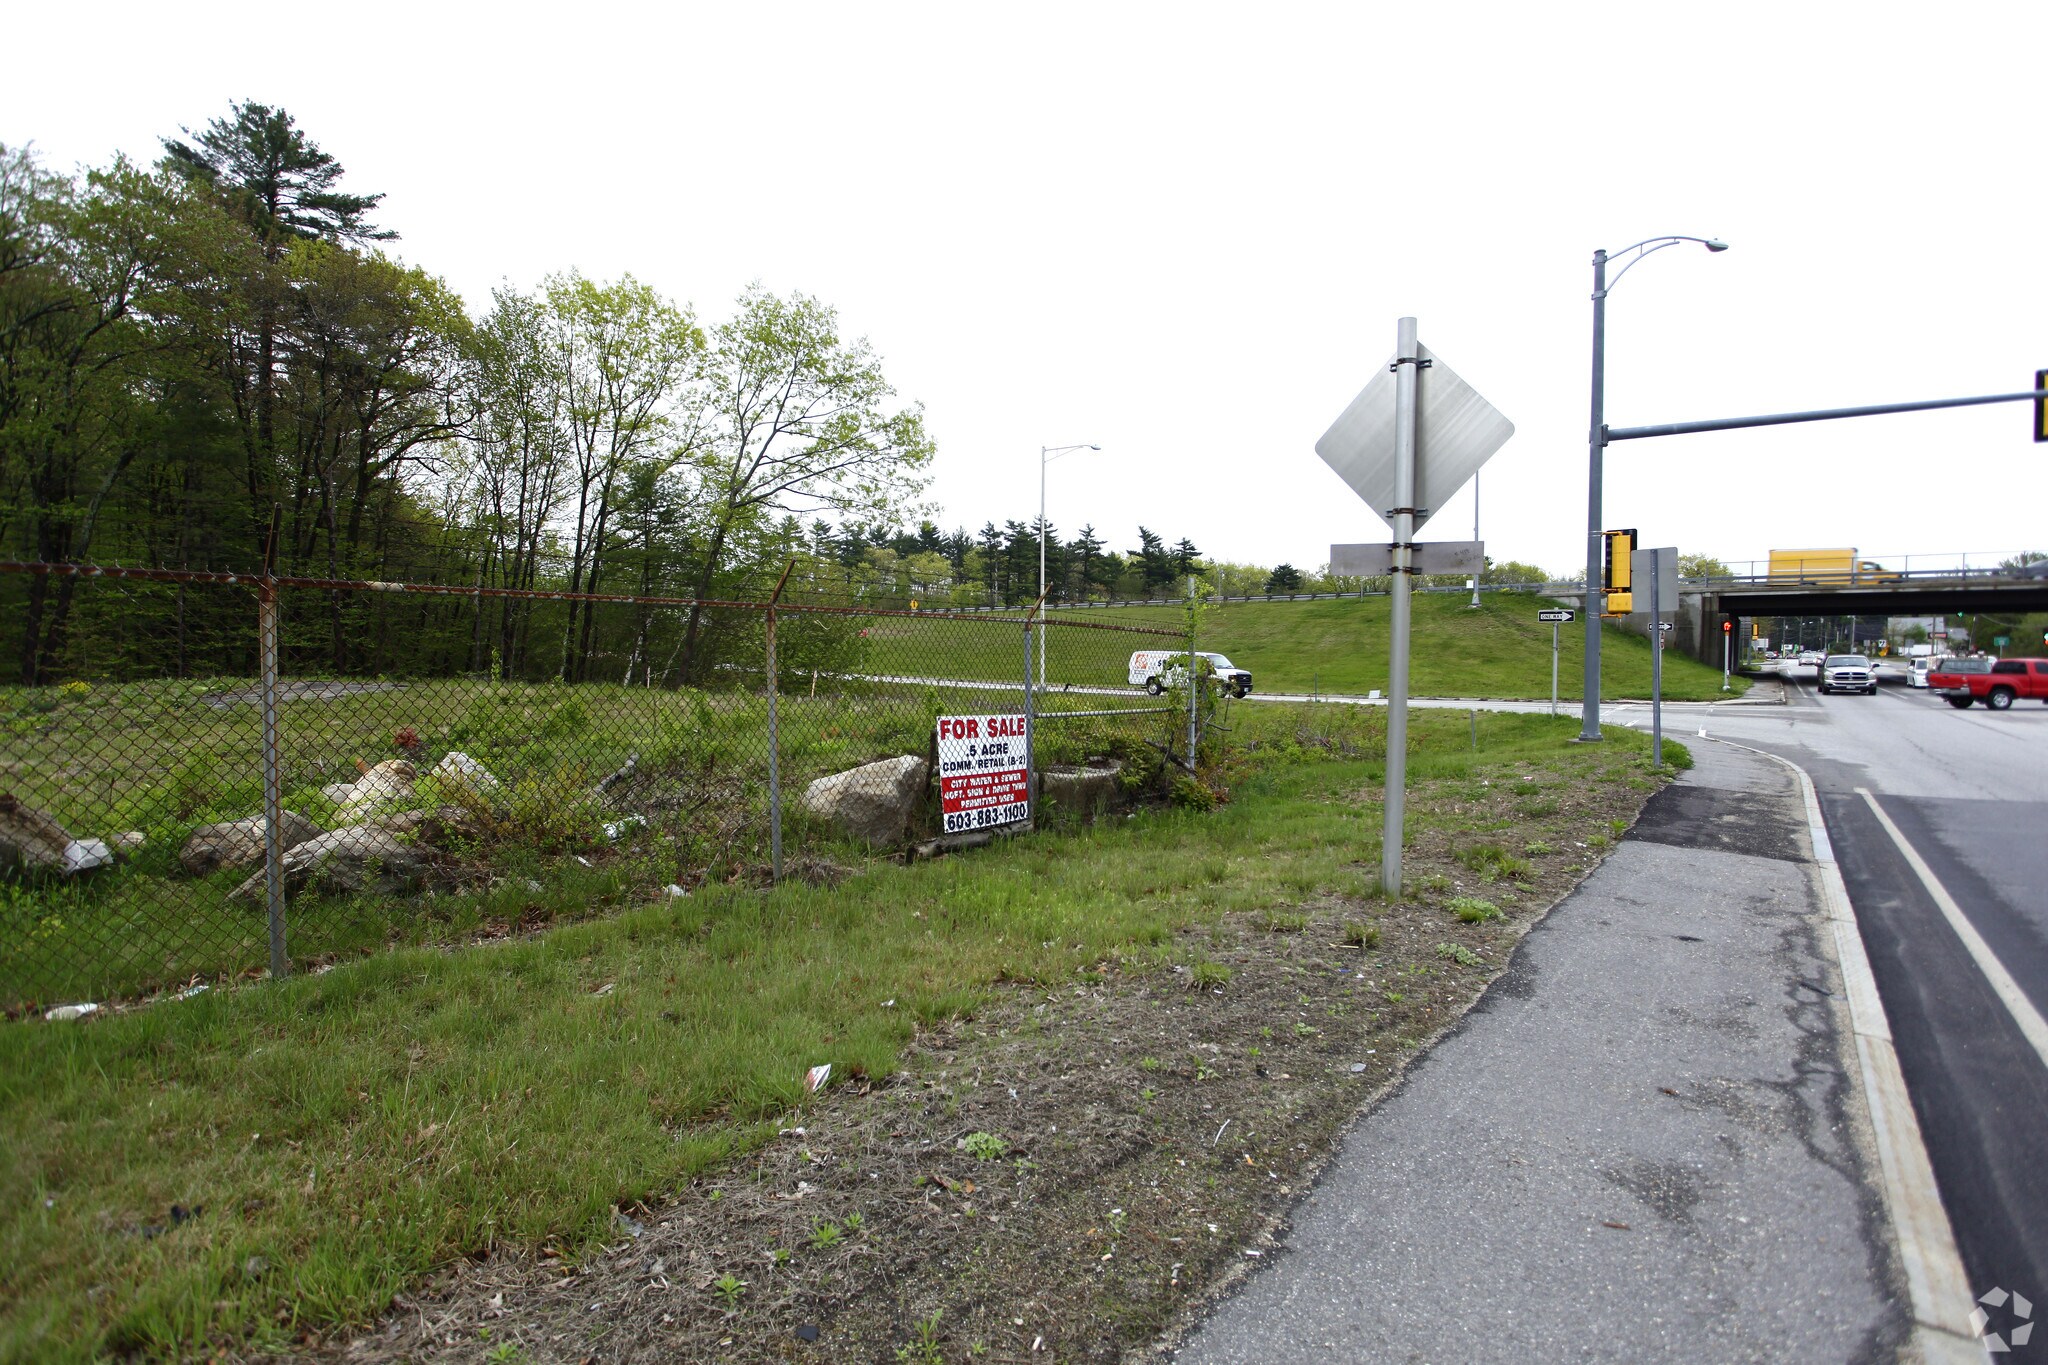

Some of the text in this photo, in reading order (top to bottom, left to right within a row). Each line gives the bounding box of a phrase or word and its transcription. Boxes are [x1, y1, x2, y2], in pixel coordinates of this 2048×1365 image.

[940, 717, 1025, 741] FOR SALE
[966, 743, 1009, 757] .5 ACRE
[943, 755, 1026, 772] COMM. RETAIL (B-2)
[950, 778, 968, 789] CITY
[970, 776, 992, 786] WATER
[1001, 773, 1021, 783] SEWER
[967, 787, 983, 797] SIGN
[992, 784, 1010, 794] DRIVE
[1012, 782, 1027, 791] THRU
[960, 793, 1015, 808] PERMITTED USES
[947, 803, 1026, 831] 603-883-1100
